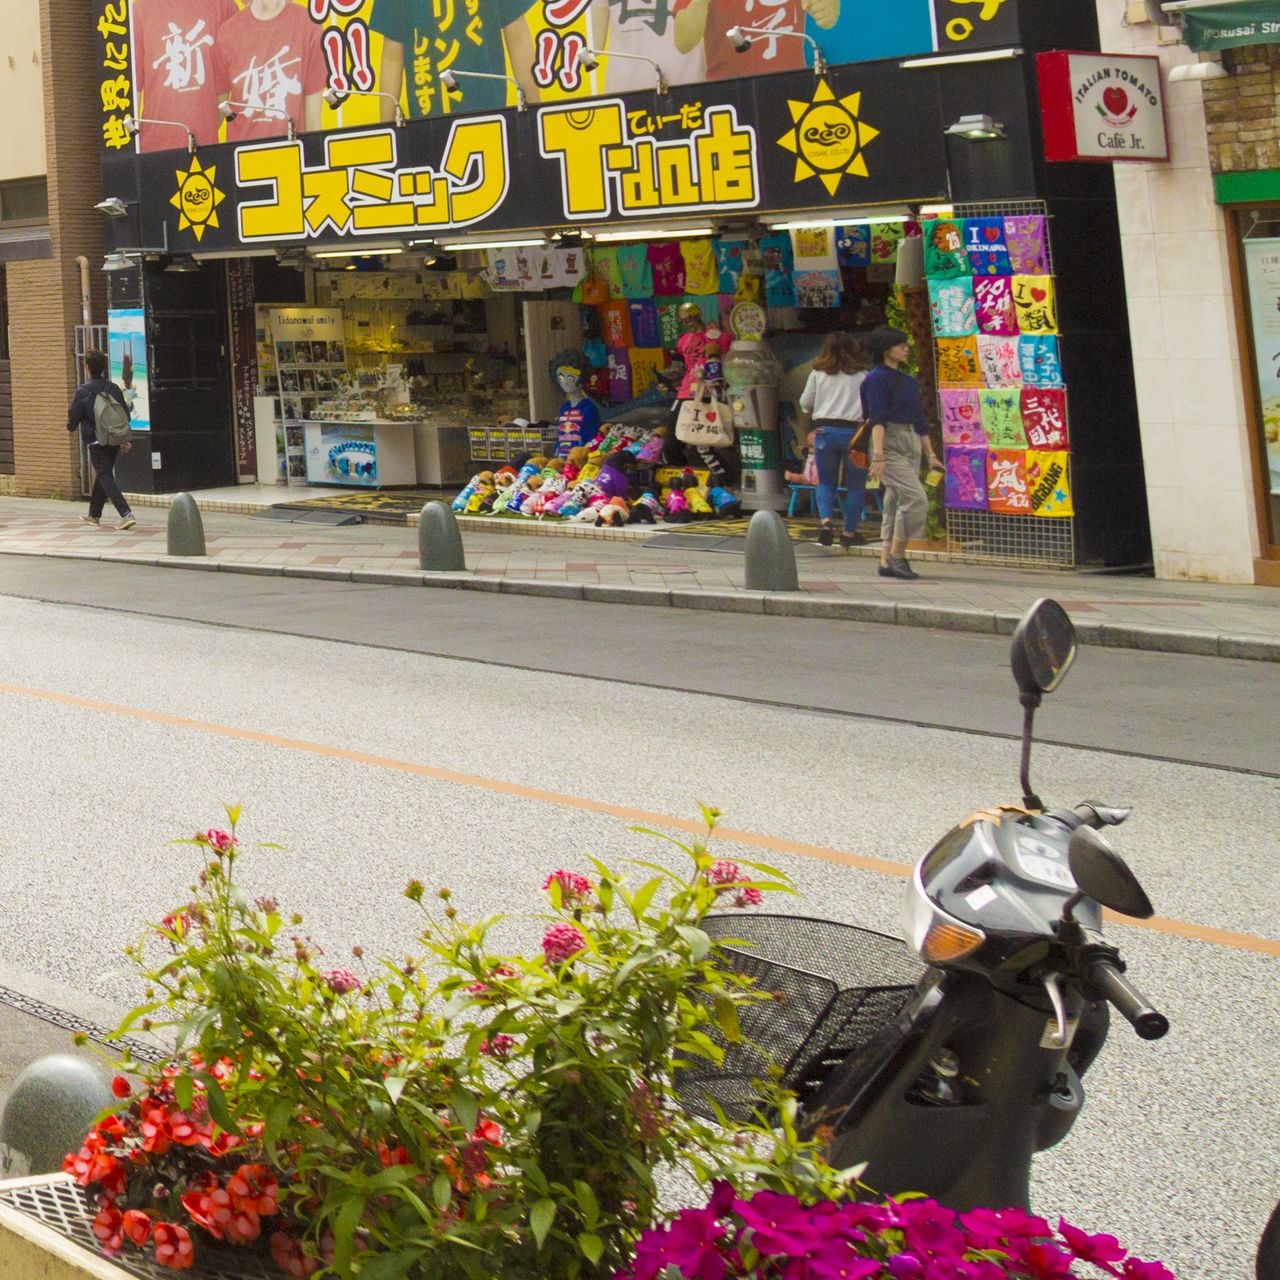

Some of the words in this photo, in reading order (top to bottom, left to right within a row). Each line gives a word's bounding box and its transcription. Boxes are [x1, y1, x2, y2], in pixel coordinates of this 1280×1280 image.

[152, 19, 214, 92] 新
[232, 45, 302, 122] 婚
[413, 26, 433, 117] します
[1075, 68, 1111, 104] ITALIAN
[1114, 68, 1158, 107] TOMATO
[235, 114, 511, 243] コスミック
[1097, 131, 1126, 150] Café
[1129, 133, 1145, 151] Jr.
